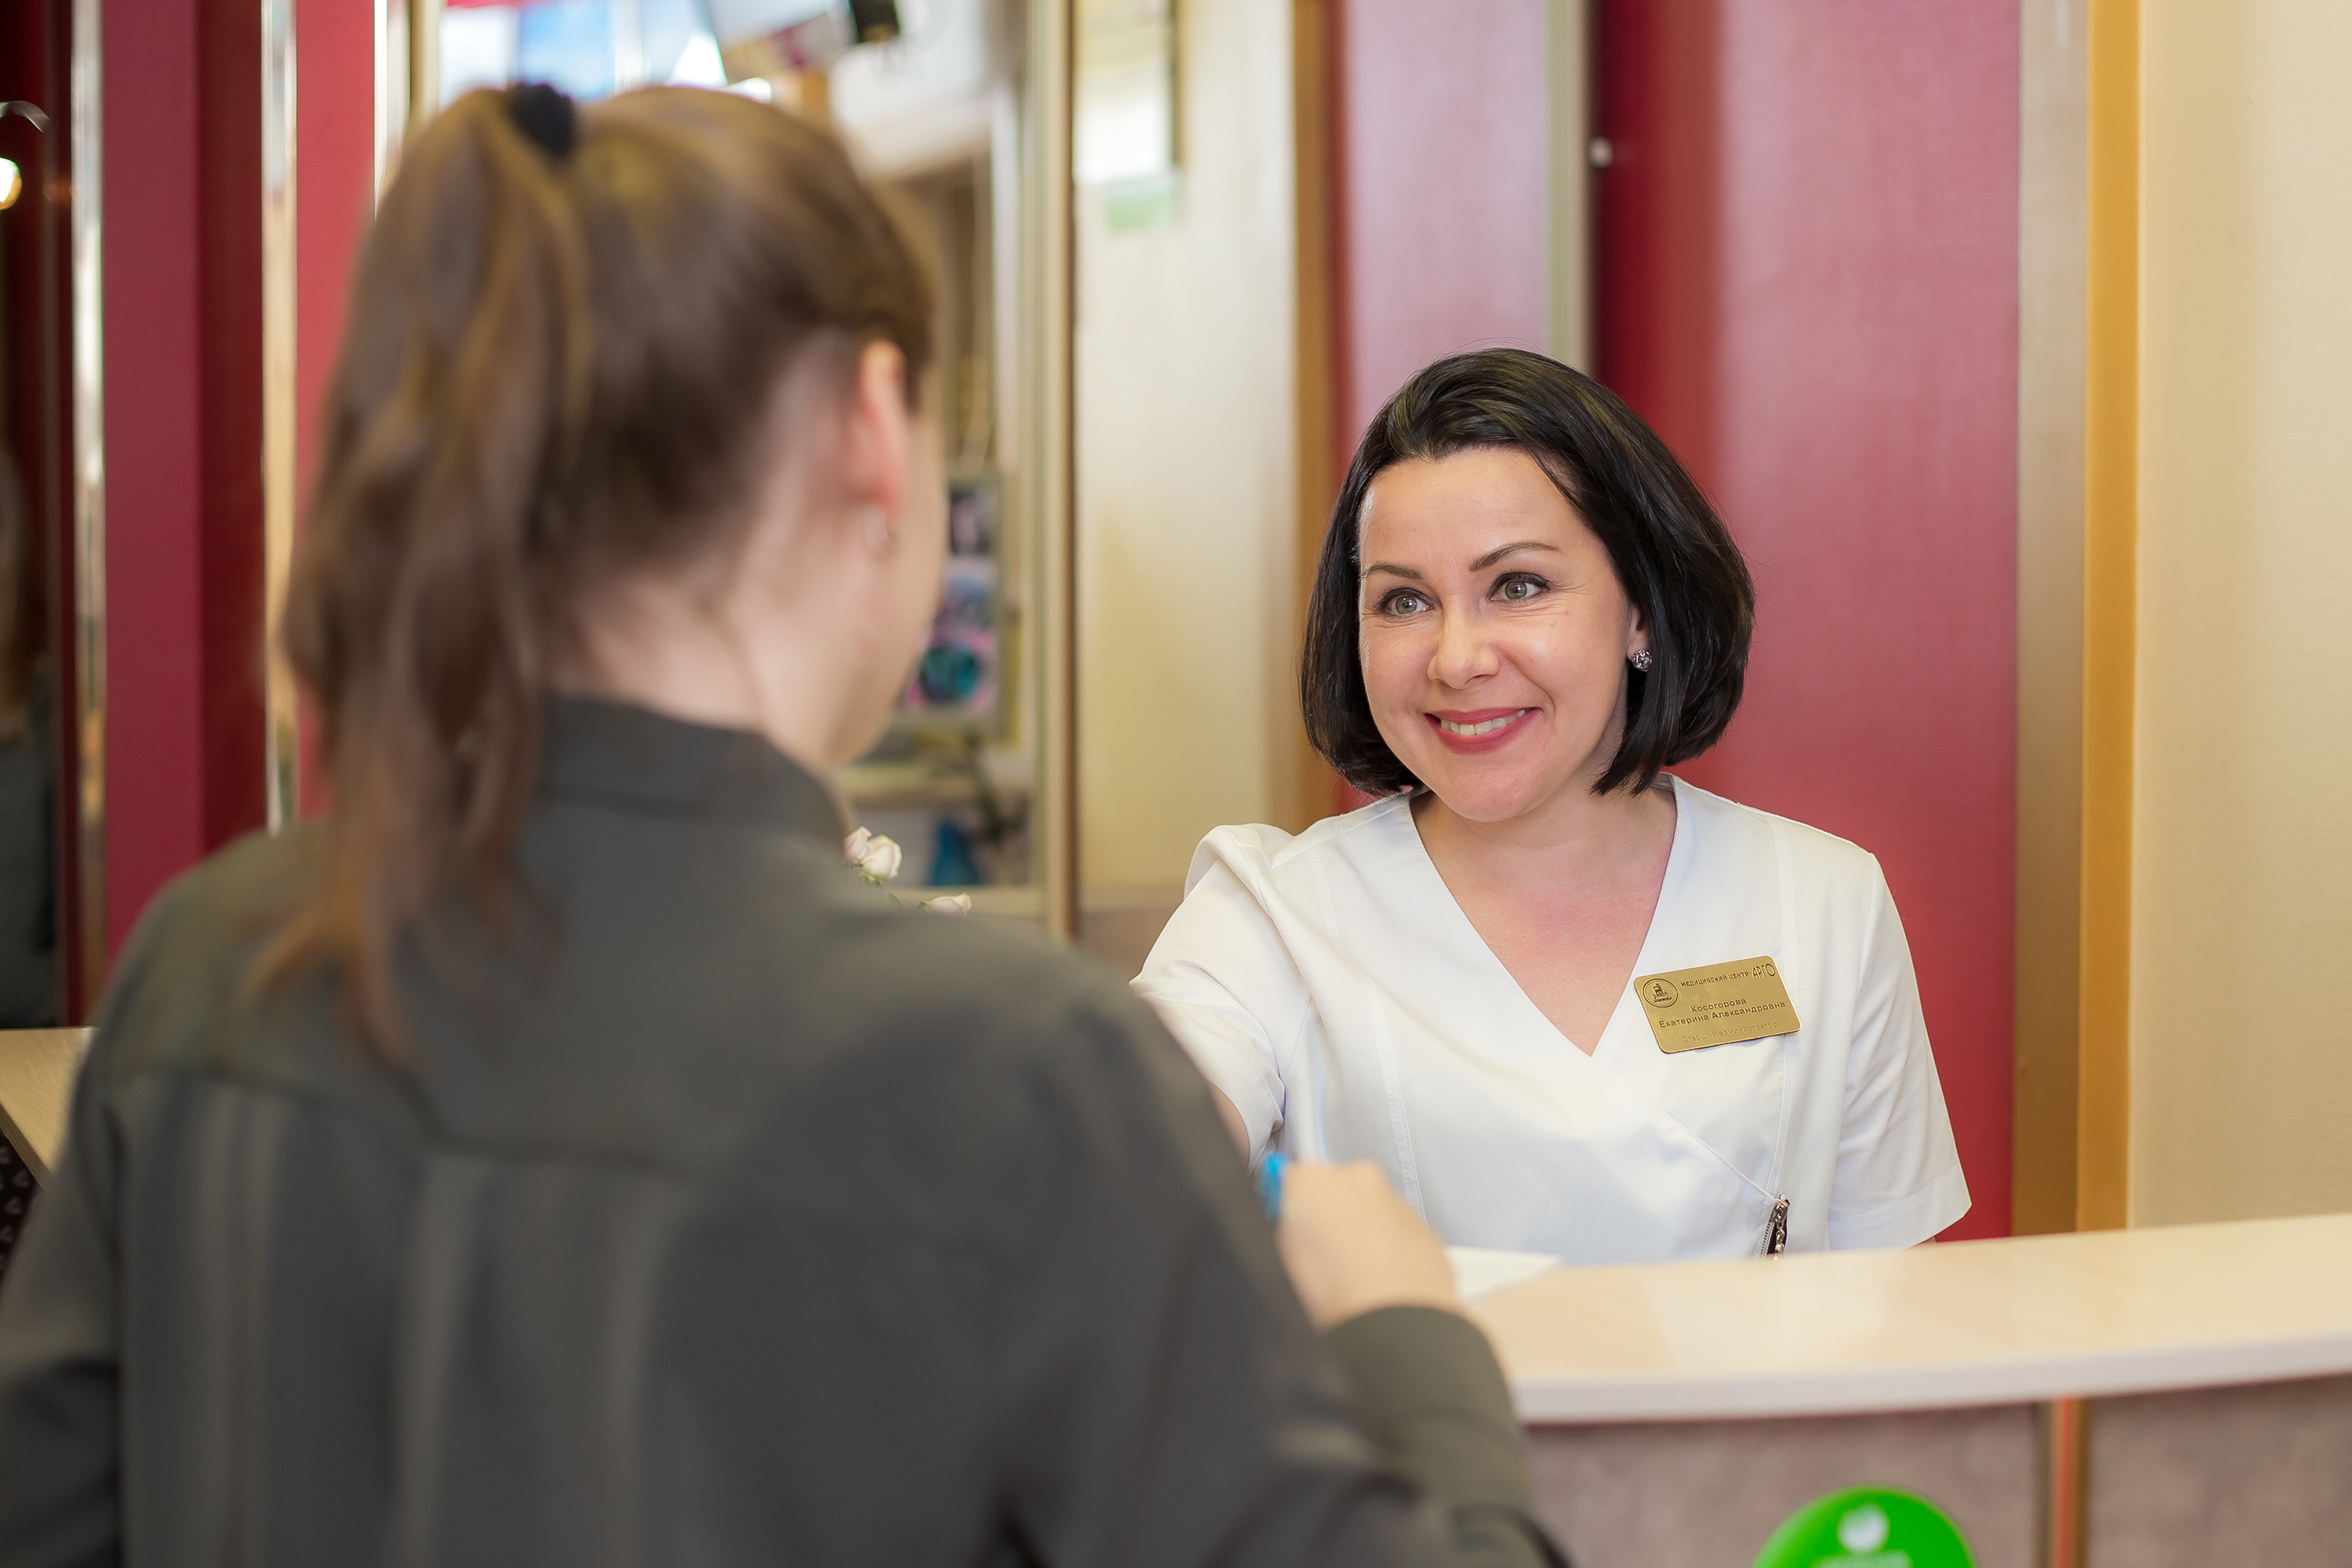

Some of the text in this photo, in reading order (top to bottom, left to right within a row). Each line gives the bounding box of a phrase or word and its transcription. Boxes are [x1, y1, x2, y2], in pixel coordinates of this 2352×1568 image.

[1680, 963, 1776, 987] МЕДИЦИНСКИЙ ЦЕНТР АРГО
[1658, 1001, 1786, 1029] Екатерина Александровна
[1690, 997, 1747, 1013] Косогорова
[1682, 1022, 1777, 1043] Старший администратор
